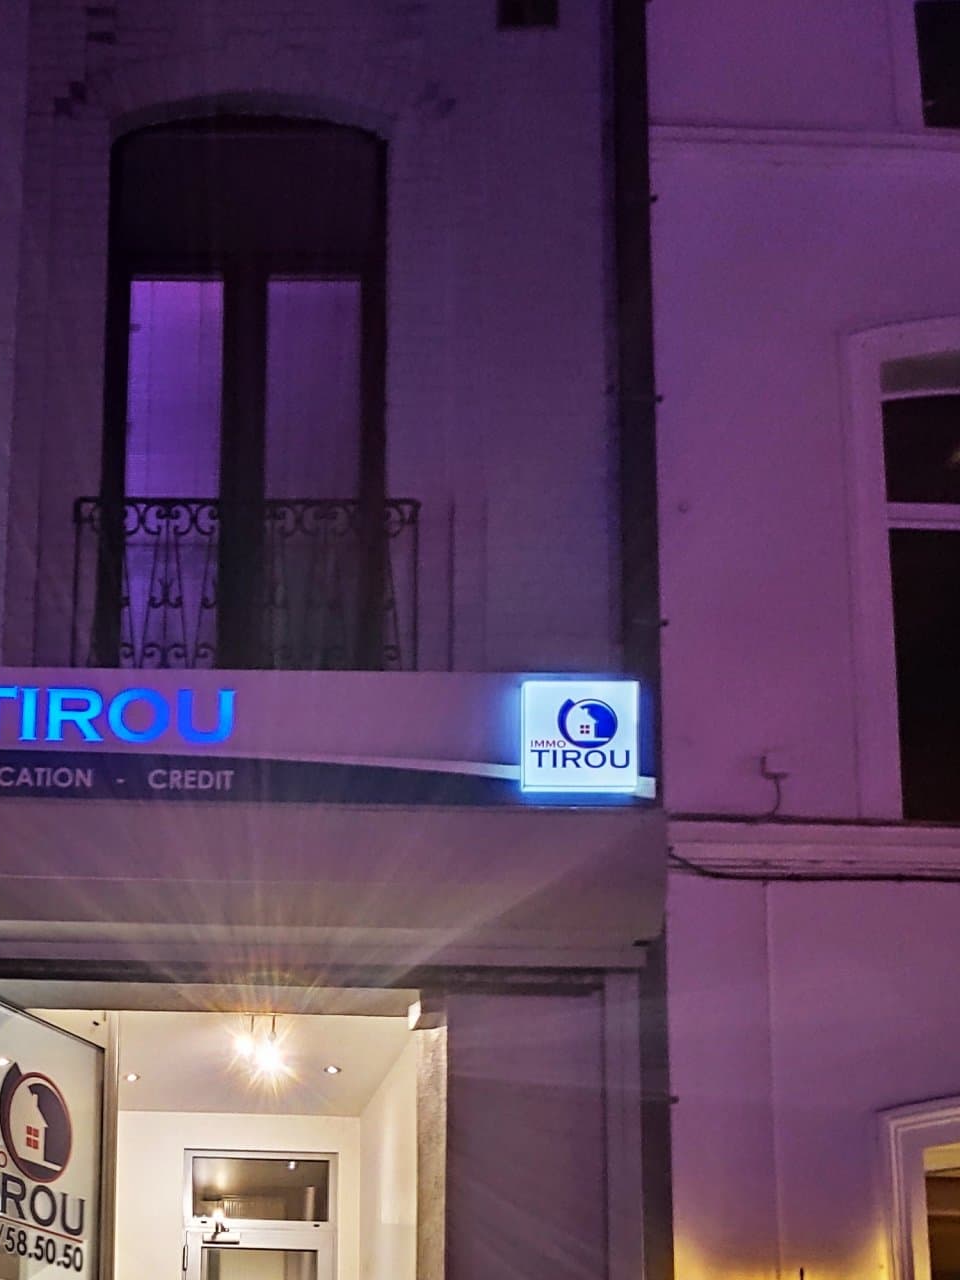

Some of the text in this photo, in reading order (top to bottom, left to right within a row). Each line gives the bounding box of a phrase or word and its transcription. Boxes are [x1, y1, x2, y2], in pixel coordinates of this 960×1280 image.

[530, 739, 567, 749] IMMO
[530, 749, 630, 769] TIROU
[147, 769, 234, 790] CREDIT
